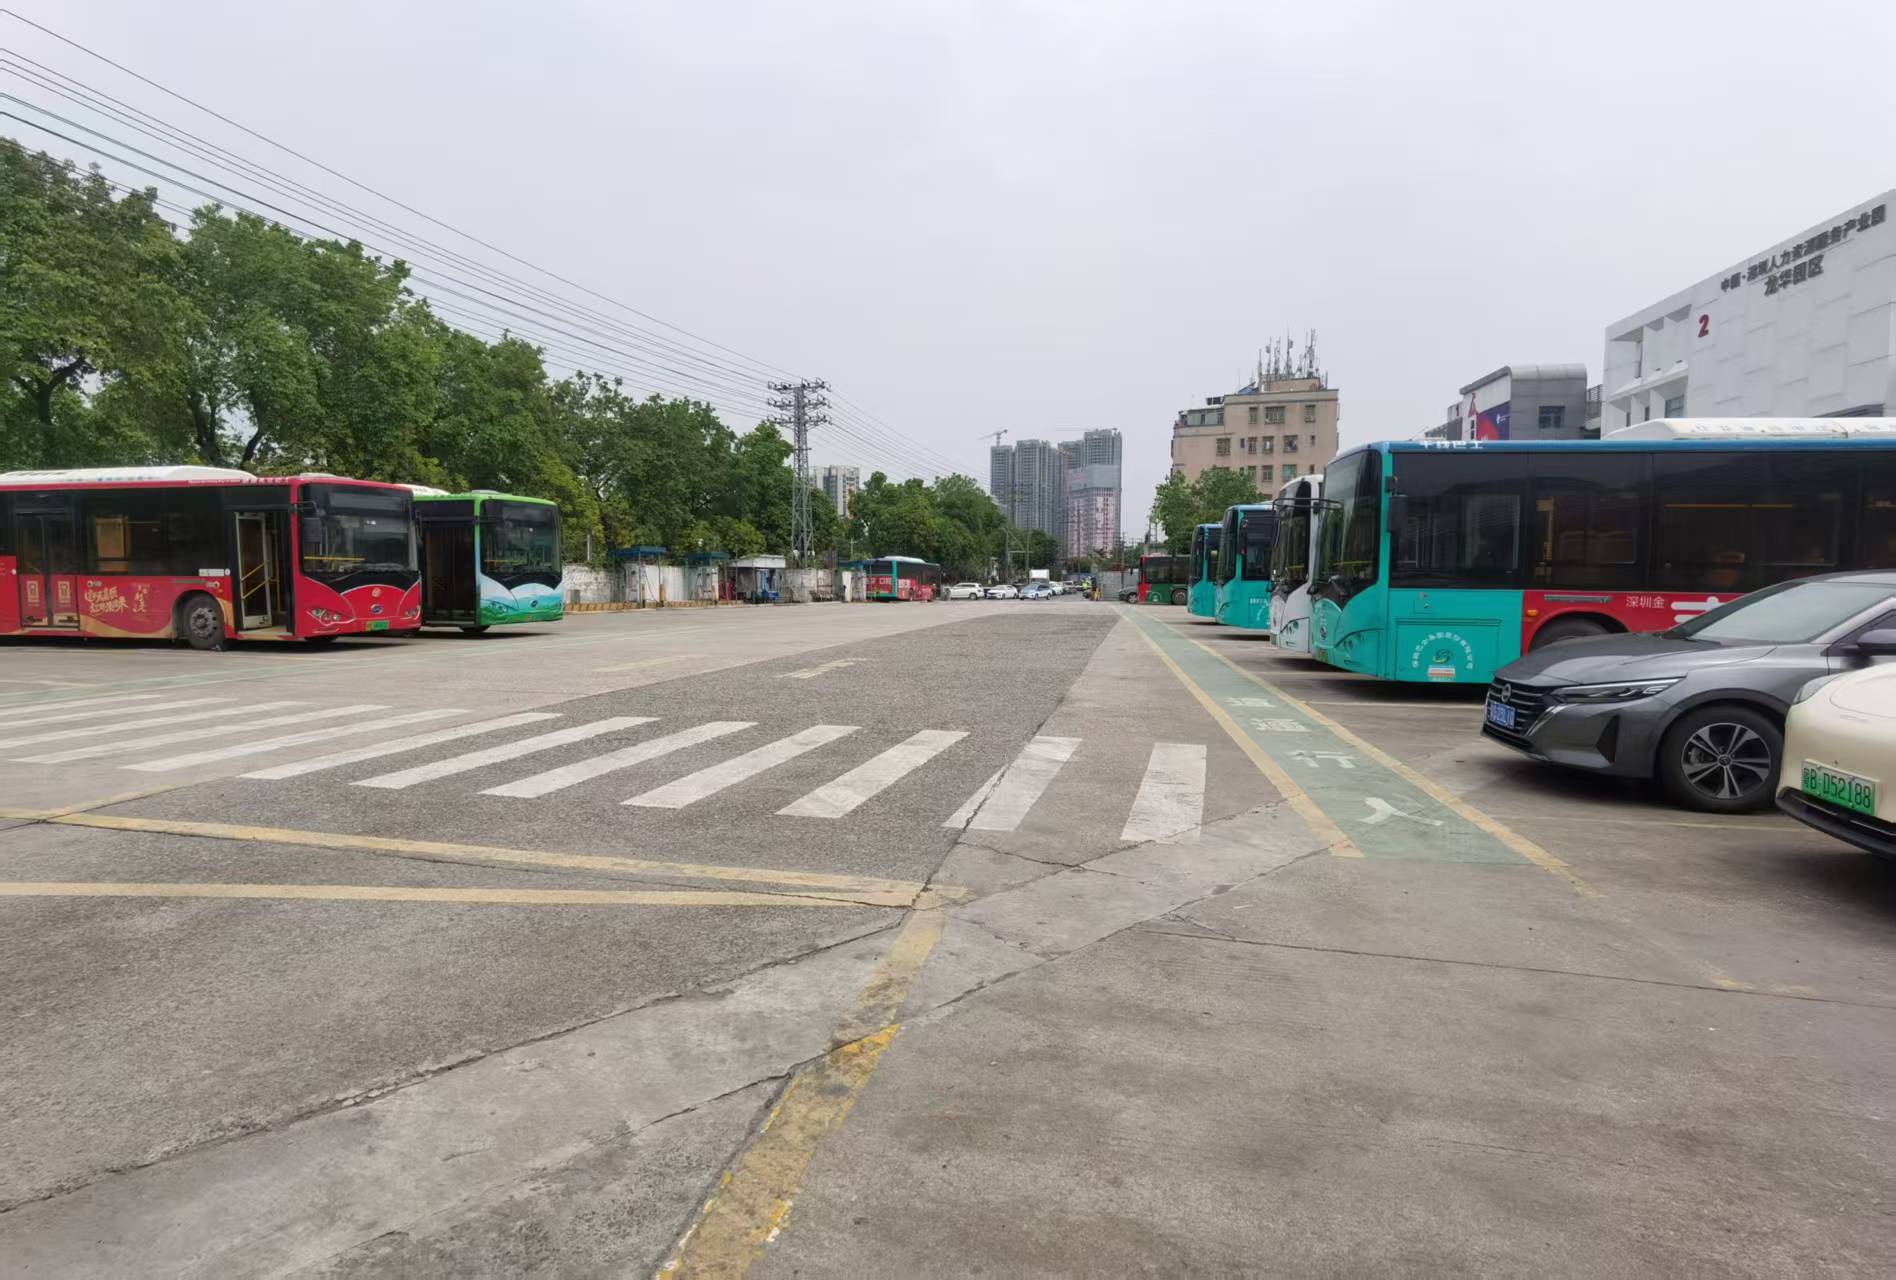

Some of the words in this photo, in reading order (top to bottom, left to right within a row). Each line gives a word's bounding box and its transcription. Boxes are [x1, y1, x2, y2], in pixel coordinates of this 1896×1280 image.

[1764, 254, 1825, 296] 龙华园区
[1697, 314, 1710, 338] 2
[1625, 595, 1665, 608] 深圳金
